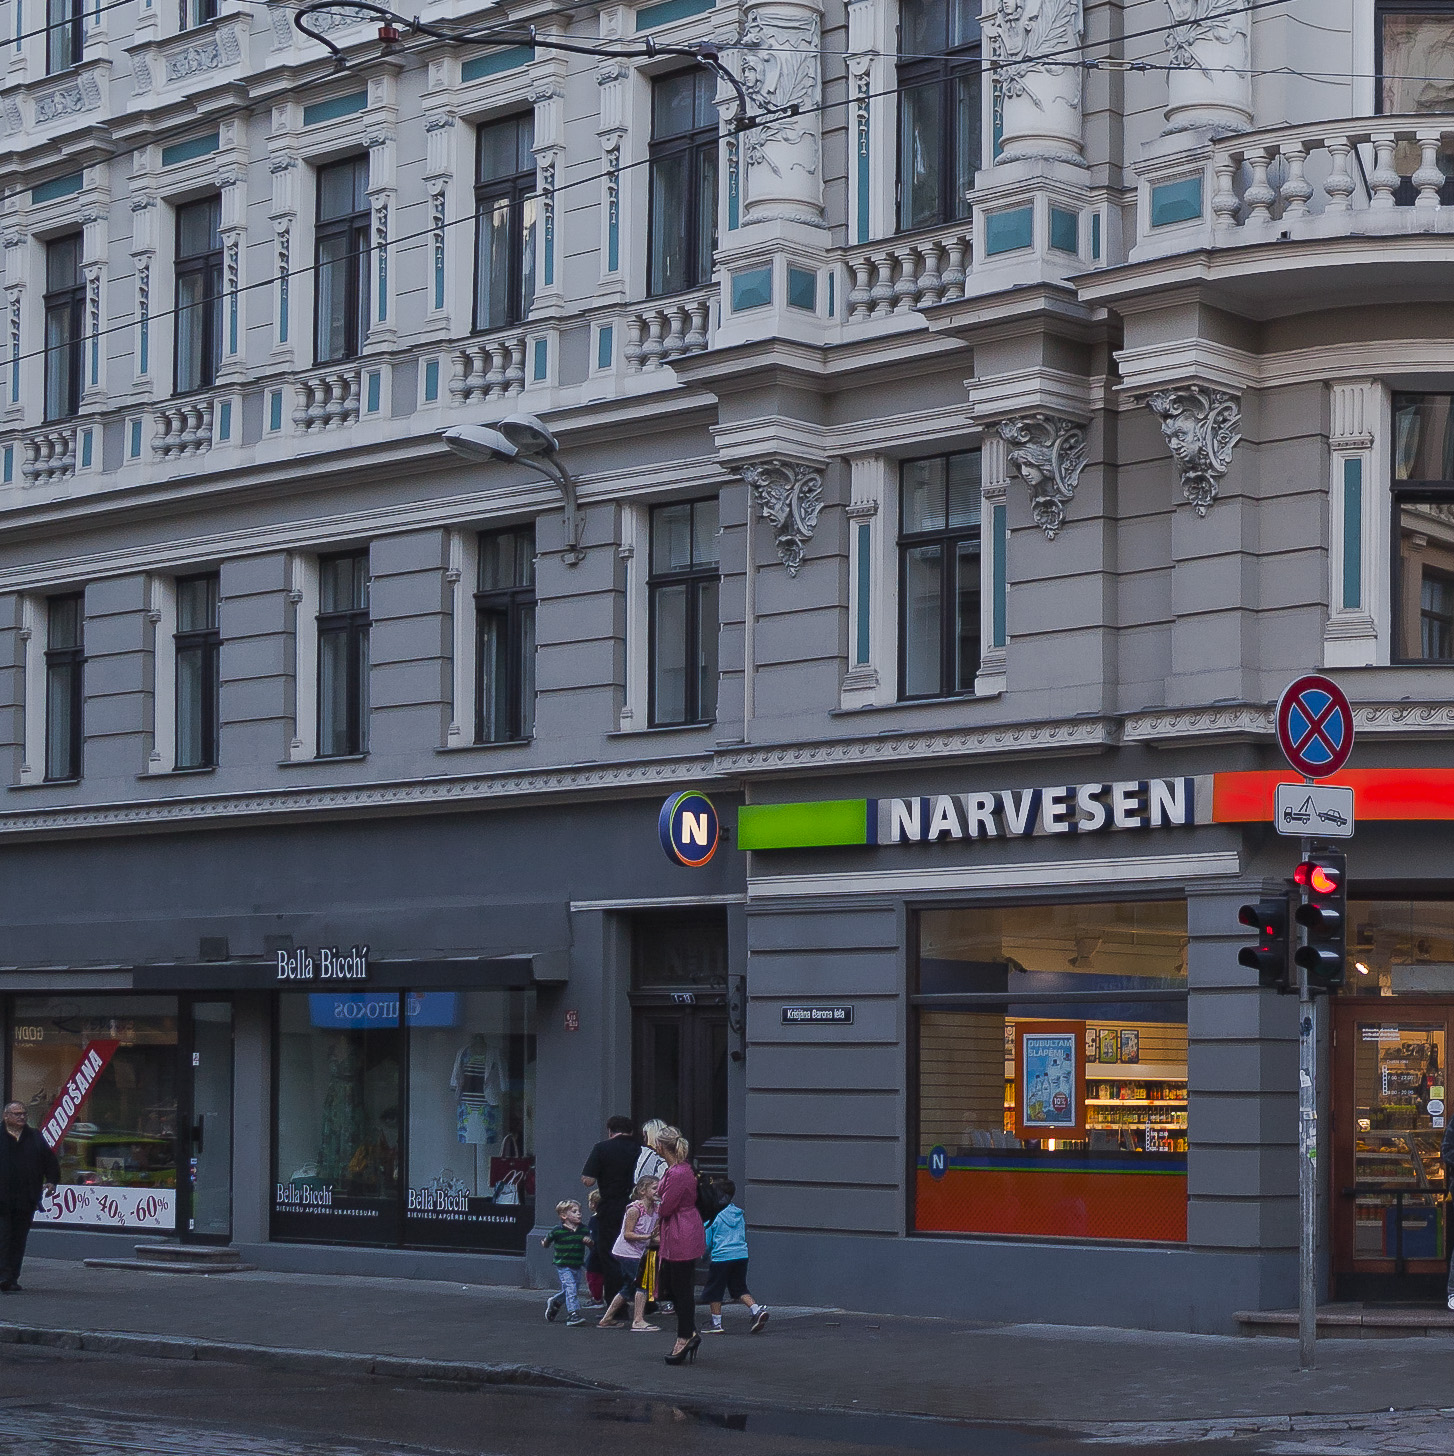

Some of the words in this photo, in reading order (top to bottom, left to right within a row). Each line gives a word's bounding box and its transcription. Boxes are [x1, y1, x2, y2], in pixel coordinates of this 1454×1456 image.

[890, 777, 1186, 842] NARVESEN
[681, 811, 708, 846] N
[276, 947, 313, 979] Bella
[932, 1153, 944, 1169] N
[276, 1183, 300, 1203] Bella
[407, 1189, 433, 1210] Bella
